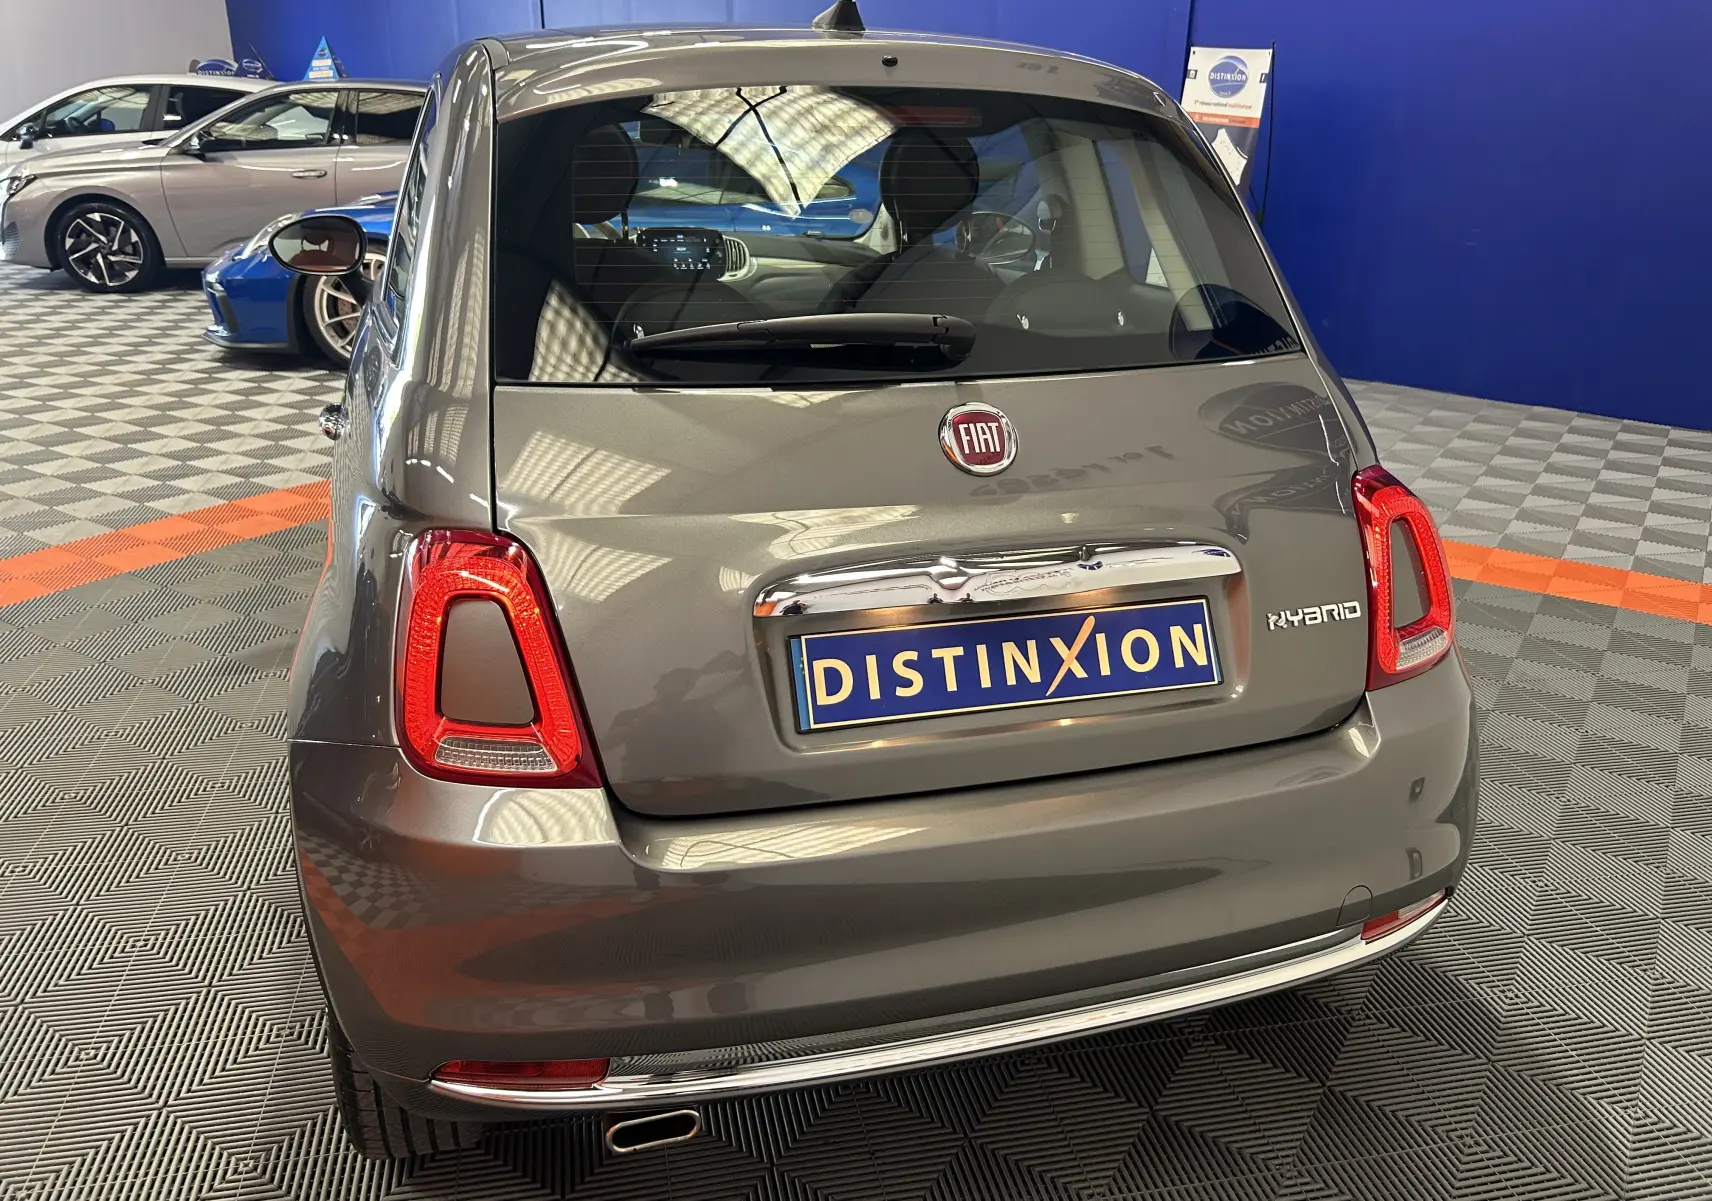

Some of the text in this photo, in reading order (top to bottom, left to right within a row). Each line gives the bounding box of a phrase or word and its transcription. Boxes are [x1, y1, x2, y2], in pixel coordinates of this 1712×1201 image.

[1210, 72, 1247, 82] DISTINXION
[958, 422, 1001, 454] FIAT
[1266, 600, 1362, 631] HYBRID
[812, 615, 1208, 706] DISTINXION
